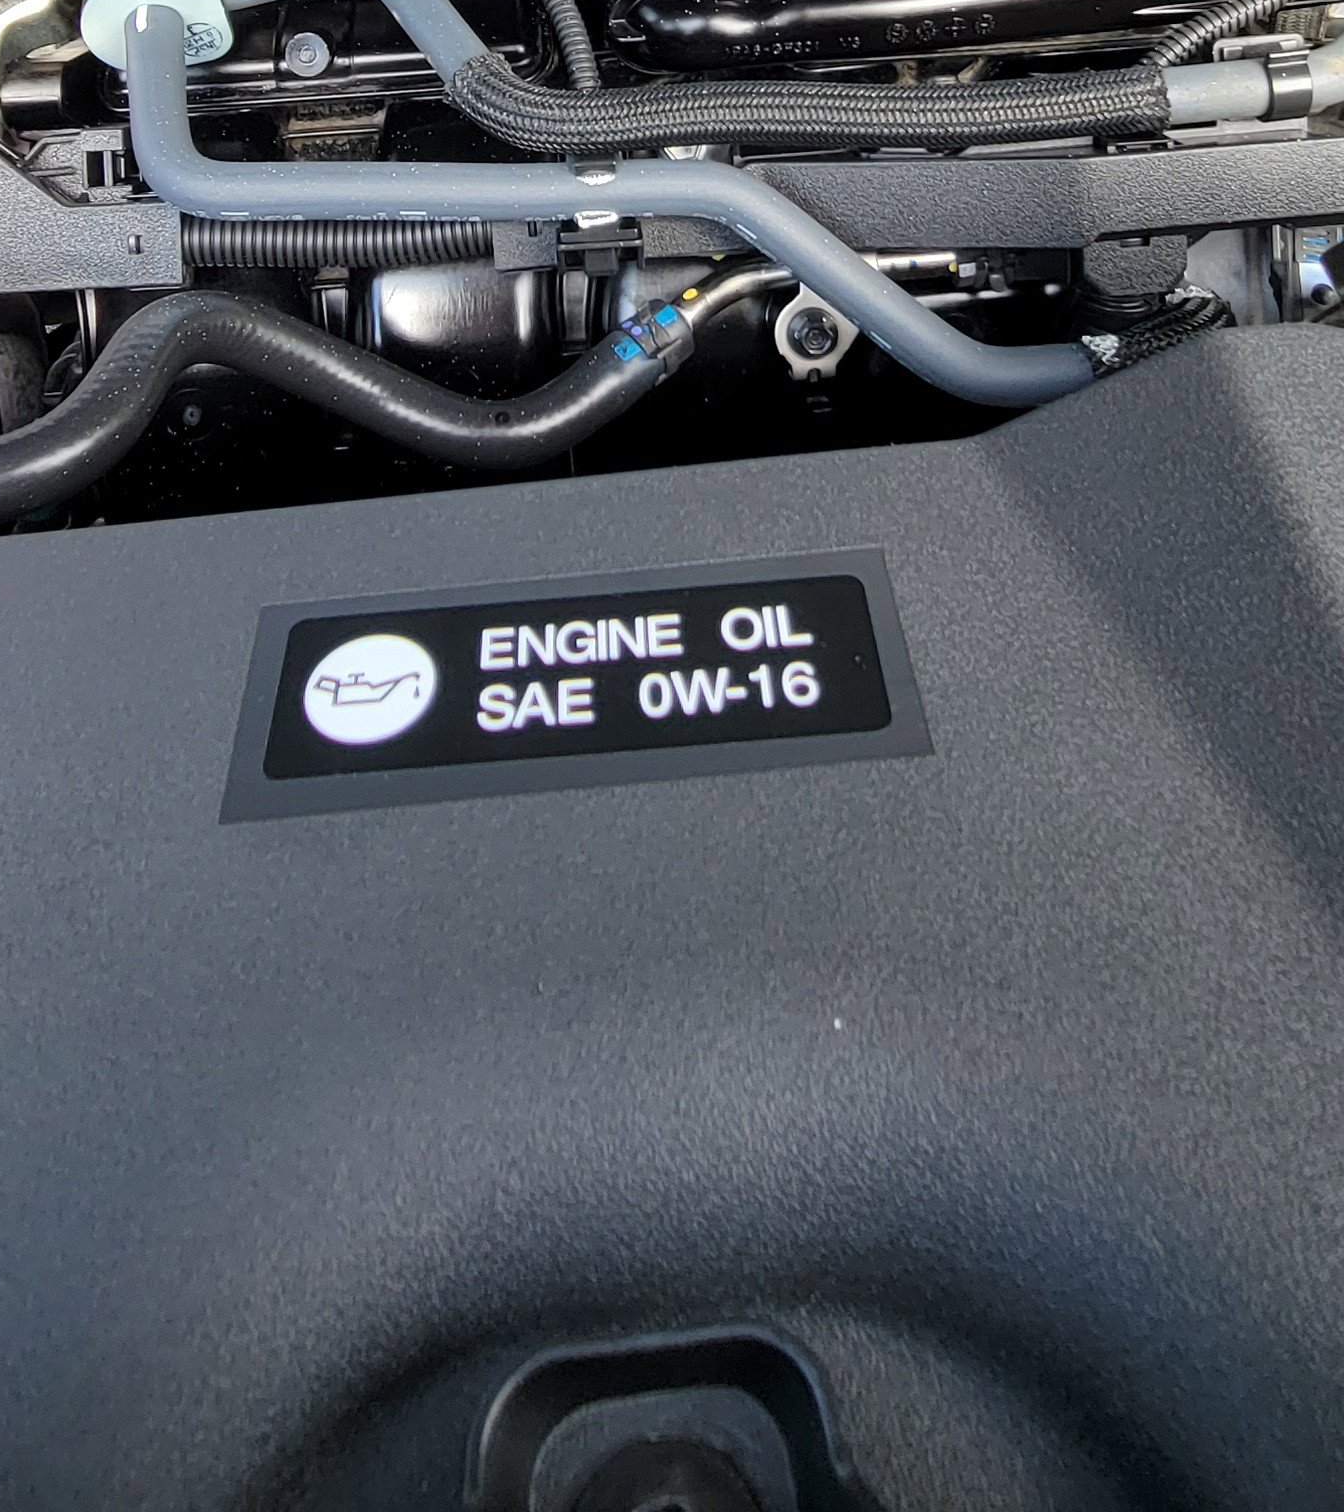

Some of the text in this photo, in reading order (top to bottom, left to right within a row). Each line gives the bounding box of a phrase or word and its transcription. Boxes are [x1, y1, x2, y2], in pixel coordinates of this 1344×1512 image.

[478, 604, 814, 671] ENGINE OIL
[476, 660, 821, 733] SAE 0W-16
